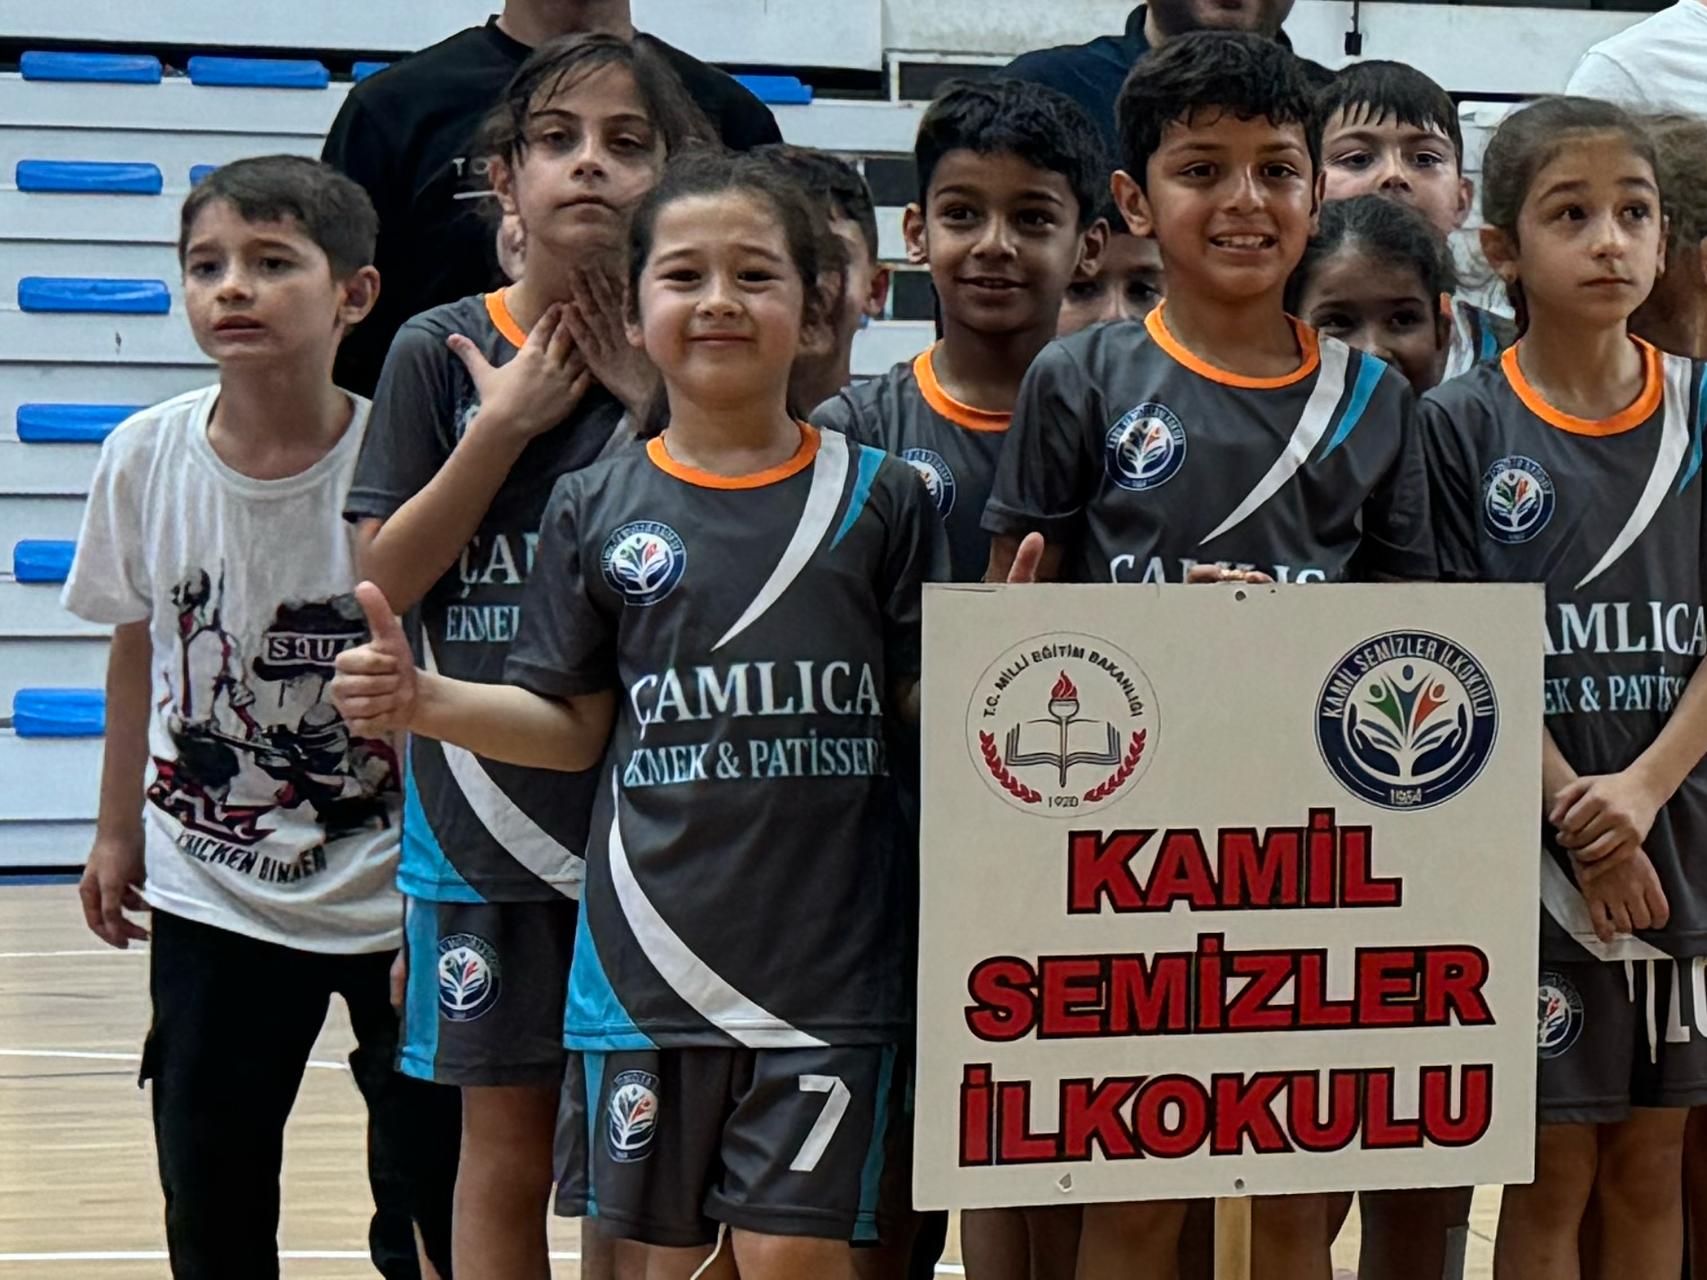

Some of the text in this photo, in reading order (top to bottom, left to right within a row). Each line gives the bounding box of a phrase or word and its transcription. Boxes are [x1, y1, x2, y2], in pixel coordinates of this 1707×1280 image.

[630, 660, 884, 741] ÇAMLICA
[995, 653, 1030, 691] MİLLİ
[1579, 675, 1601, 712] &
[716, 741, 742, 779] &
[1067, 807, 1403, 915] KAMİL
[964, 932, 1497, 1042] SEMİZLER
[790, 1074, 852, 1173] 7
[958, 1063, 1494, 1168] İLKOKULU
